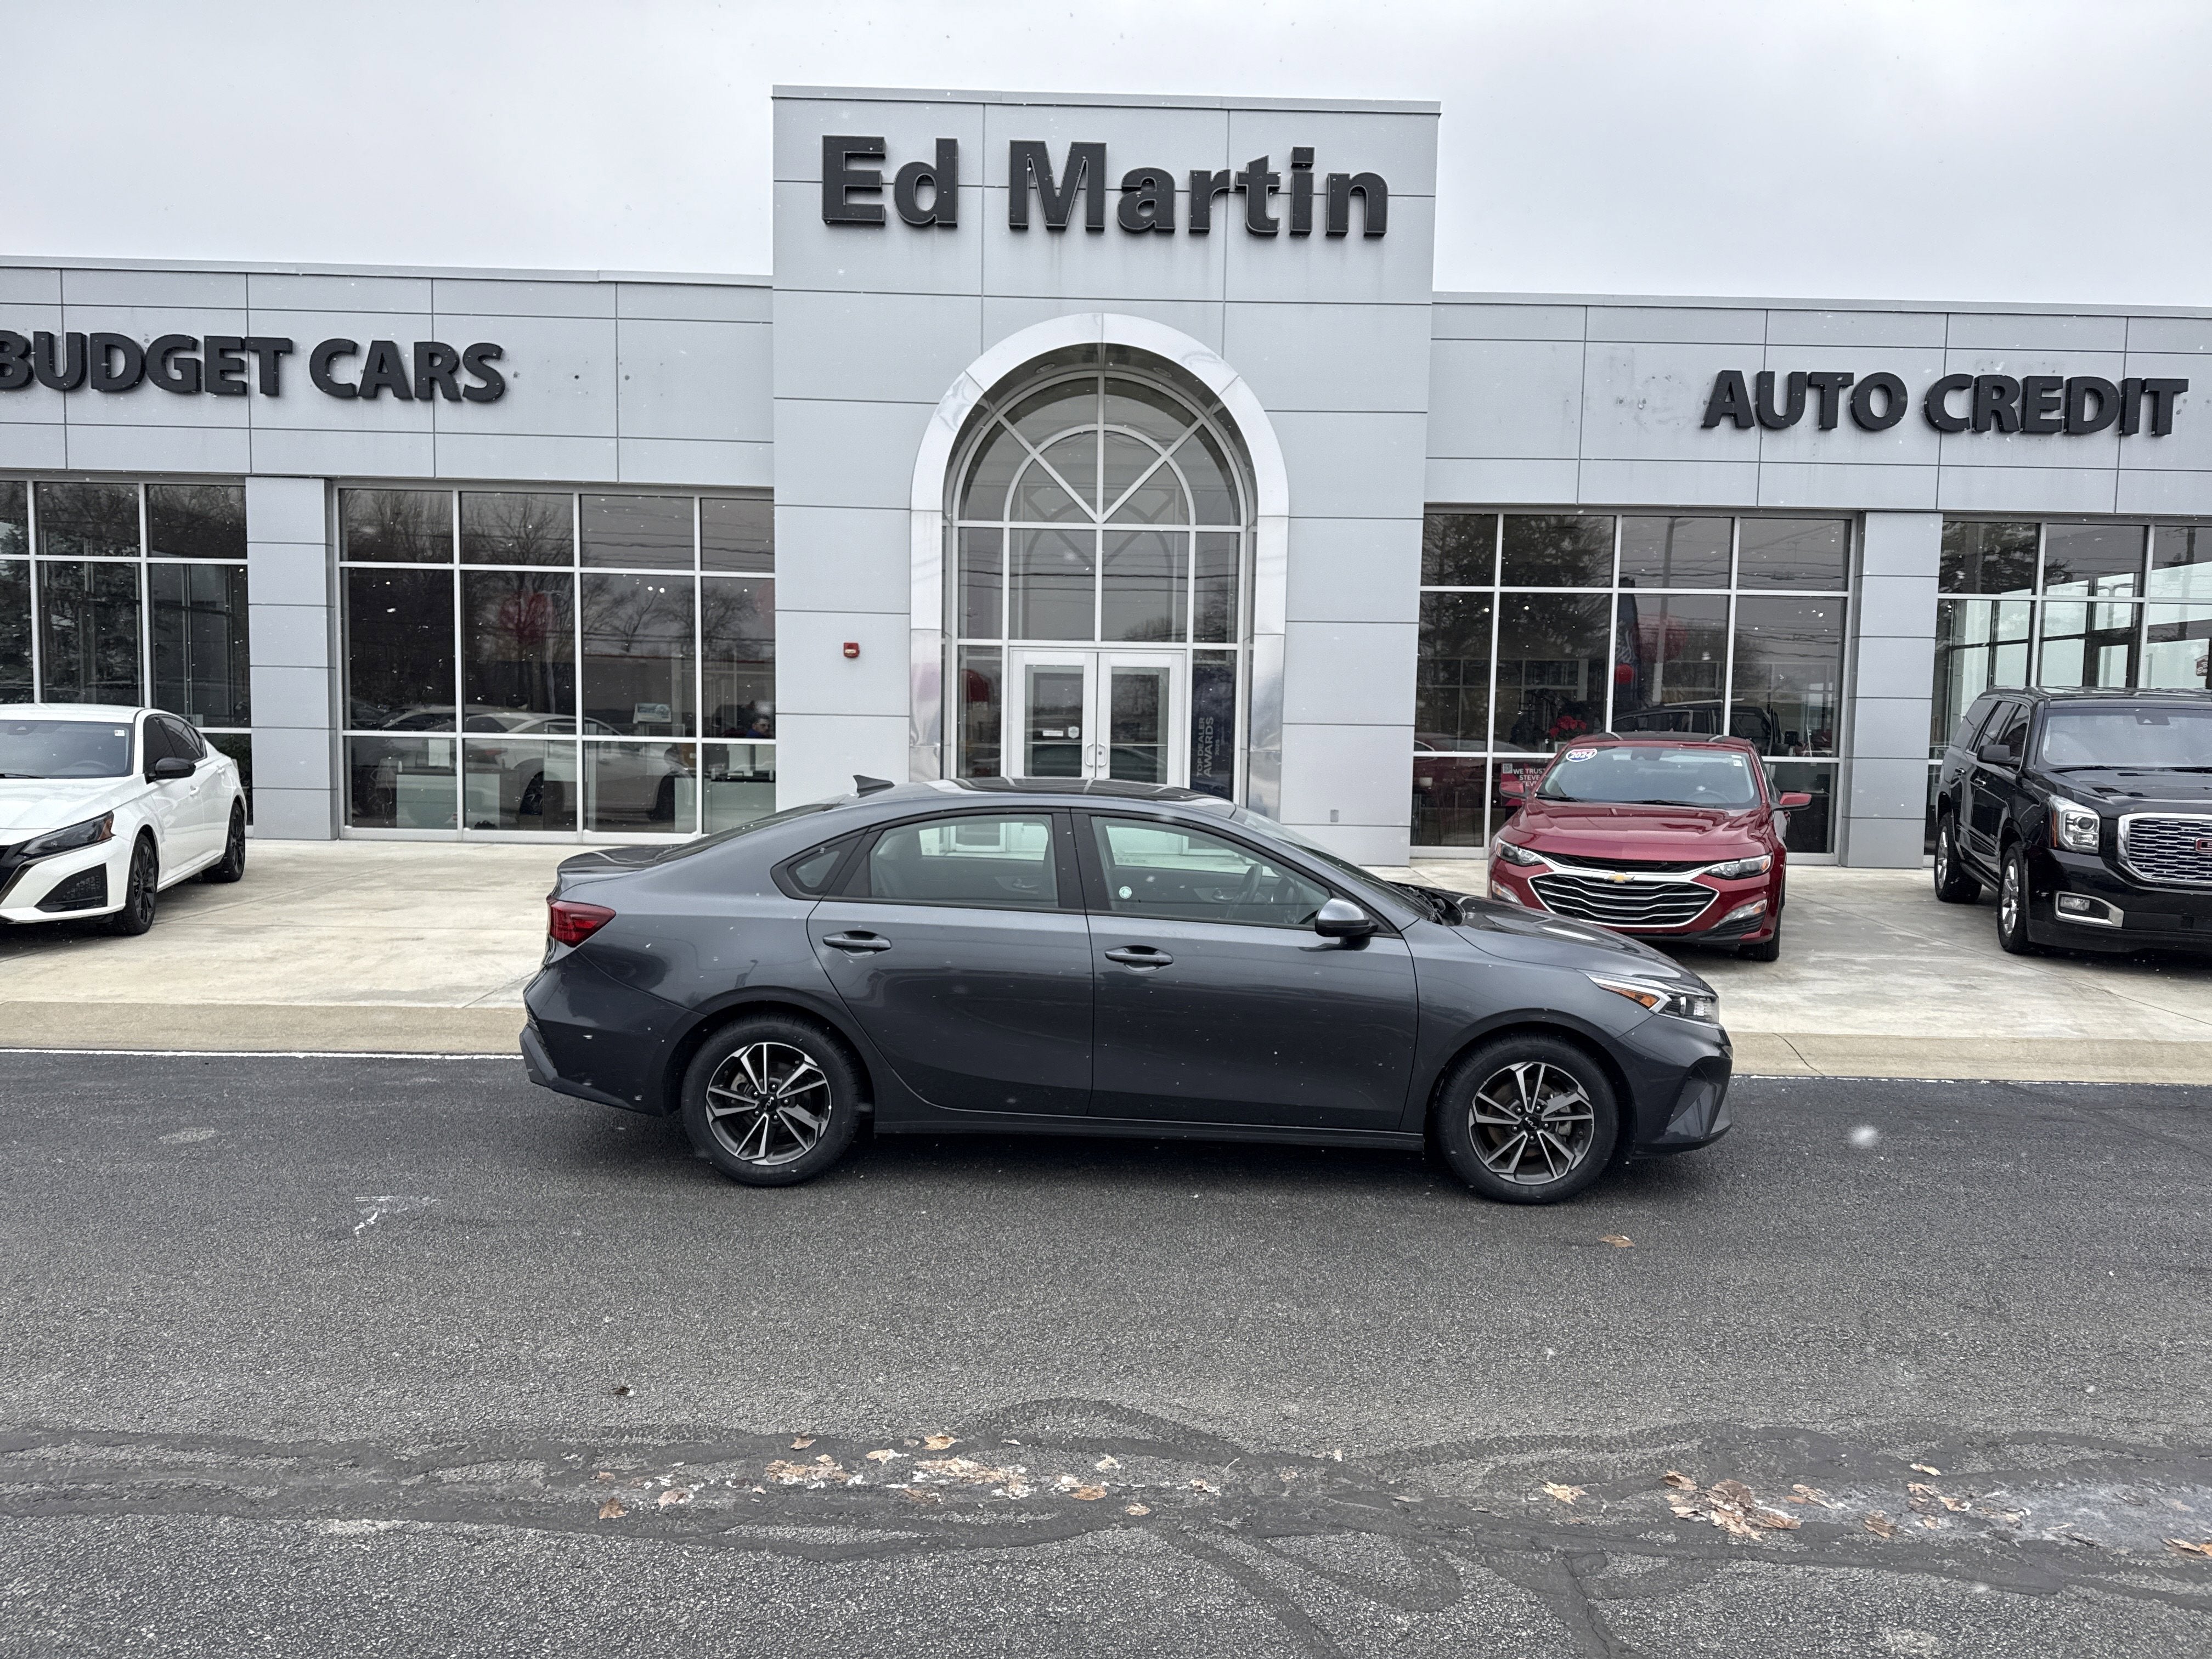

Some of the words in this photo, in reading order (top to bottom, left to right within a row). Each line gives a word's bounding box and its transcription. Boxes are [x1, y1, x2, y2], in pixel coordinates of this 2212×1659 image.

[822, 135, 958, 227] Ed
[1008, 139, 1389, 237] Martin
[0, 330, 294, 396] BUDGET
[309, 338, 505, 402] CARS
[1701, 369, 1908, 431] AUTO
[1923, 373, 2190, 437] CREDIT
[1204, 716, 1214, 777] AWARDS
